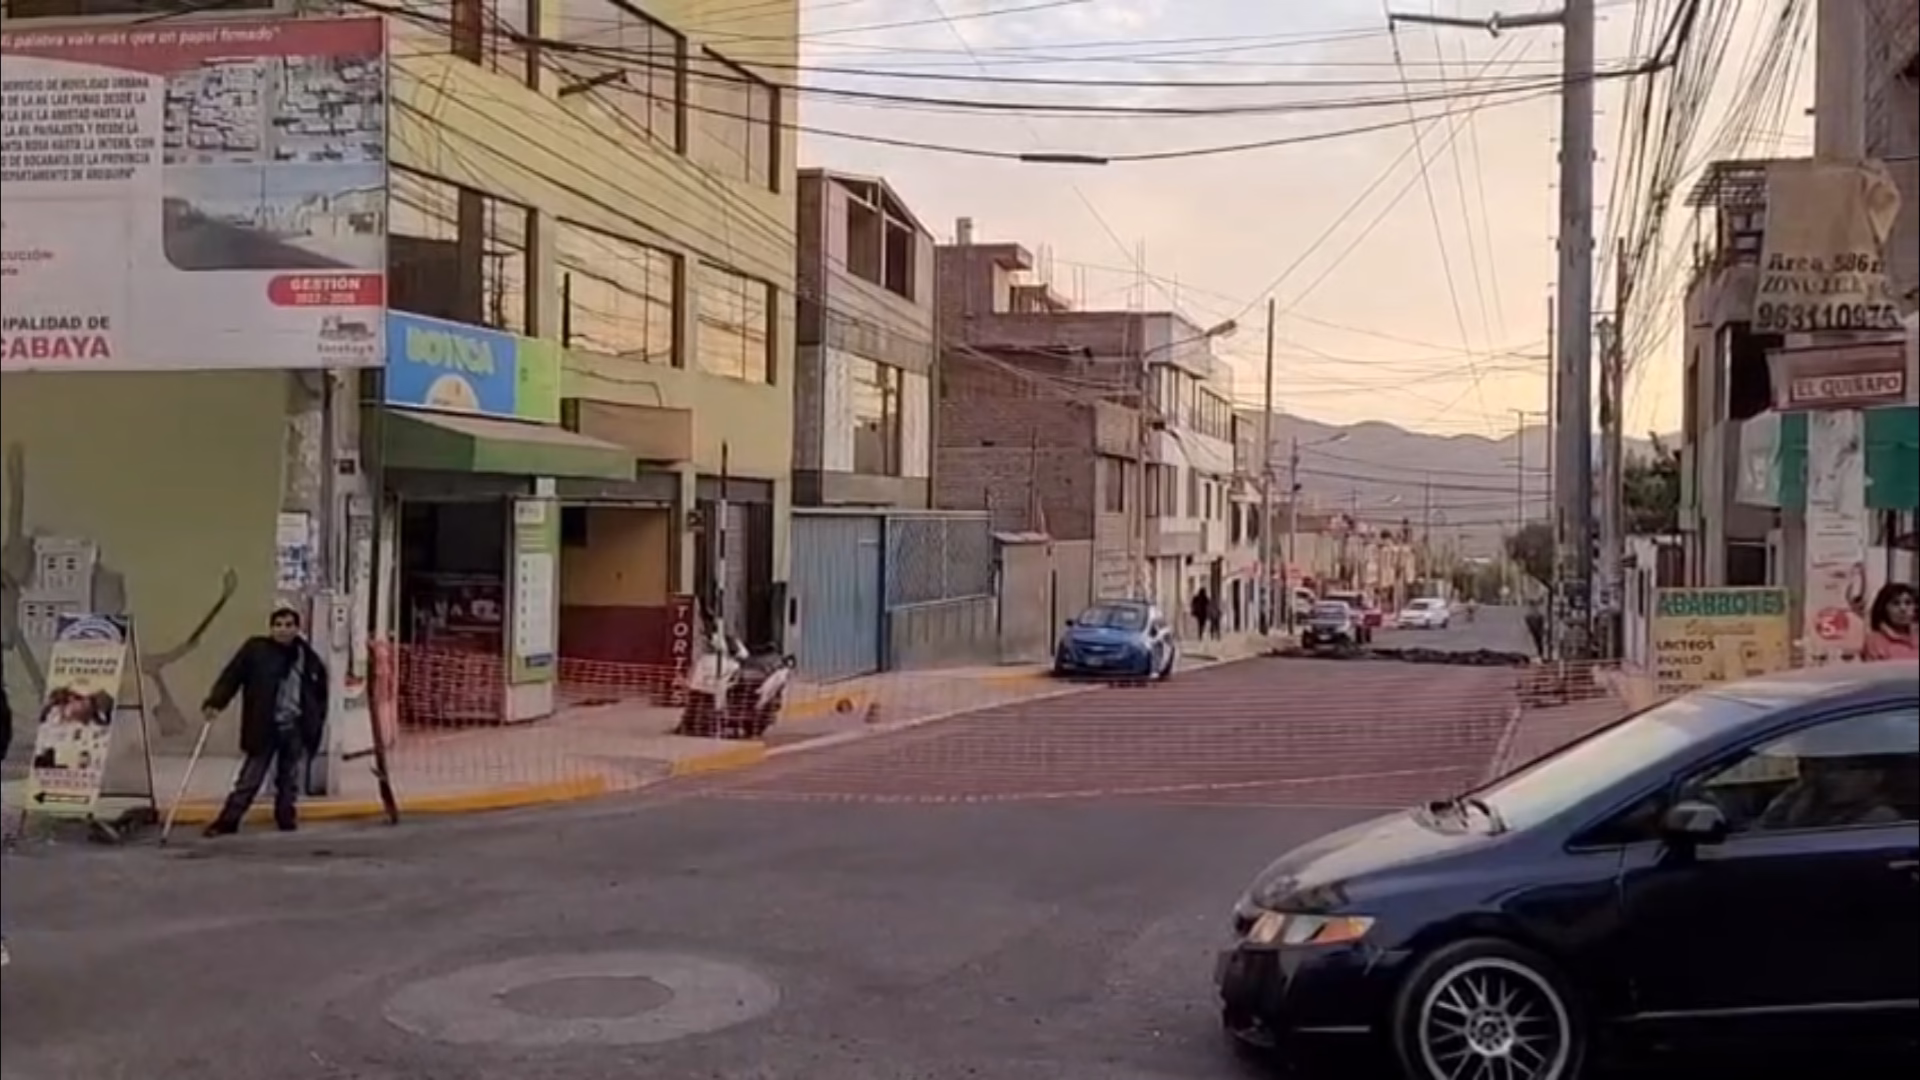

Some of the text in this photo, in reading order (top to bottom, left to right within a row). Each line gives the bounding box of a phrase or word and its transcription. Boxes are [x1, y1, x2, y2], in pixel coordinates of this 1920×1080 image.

[14, 31, 64, 49] palabra
[289, 276, 360, 291] GESTIÓN
[87, 315, 110, 331] DE
[406, 326, 496, 377] BOTICA
[1656, 591, 1786, 617] ABARROTES
